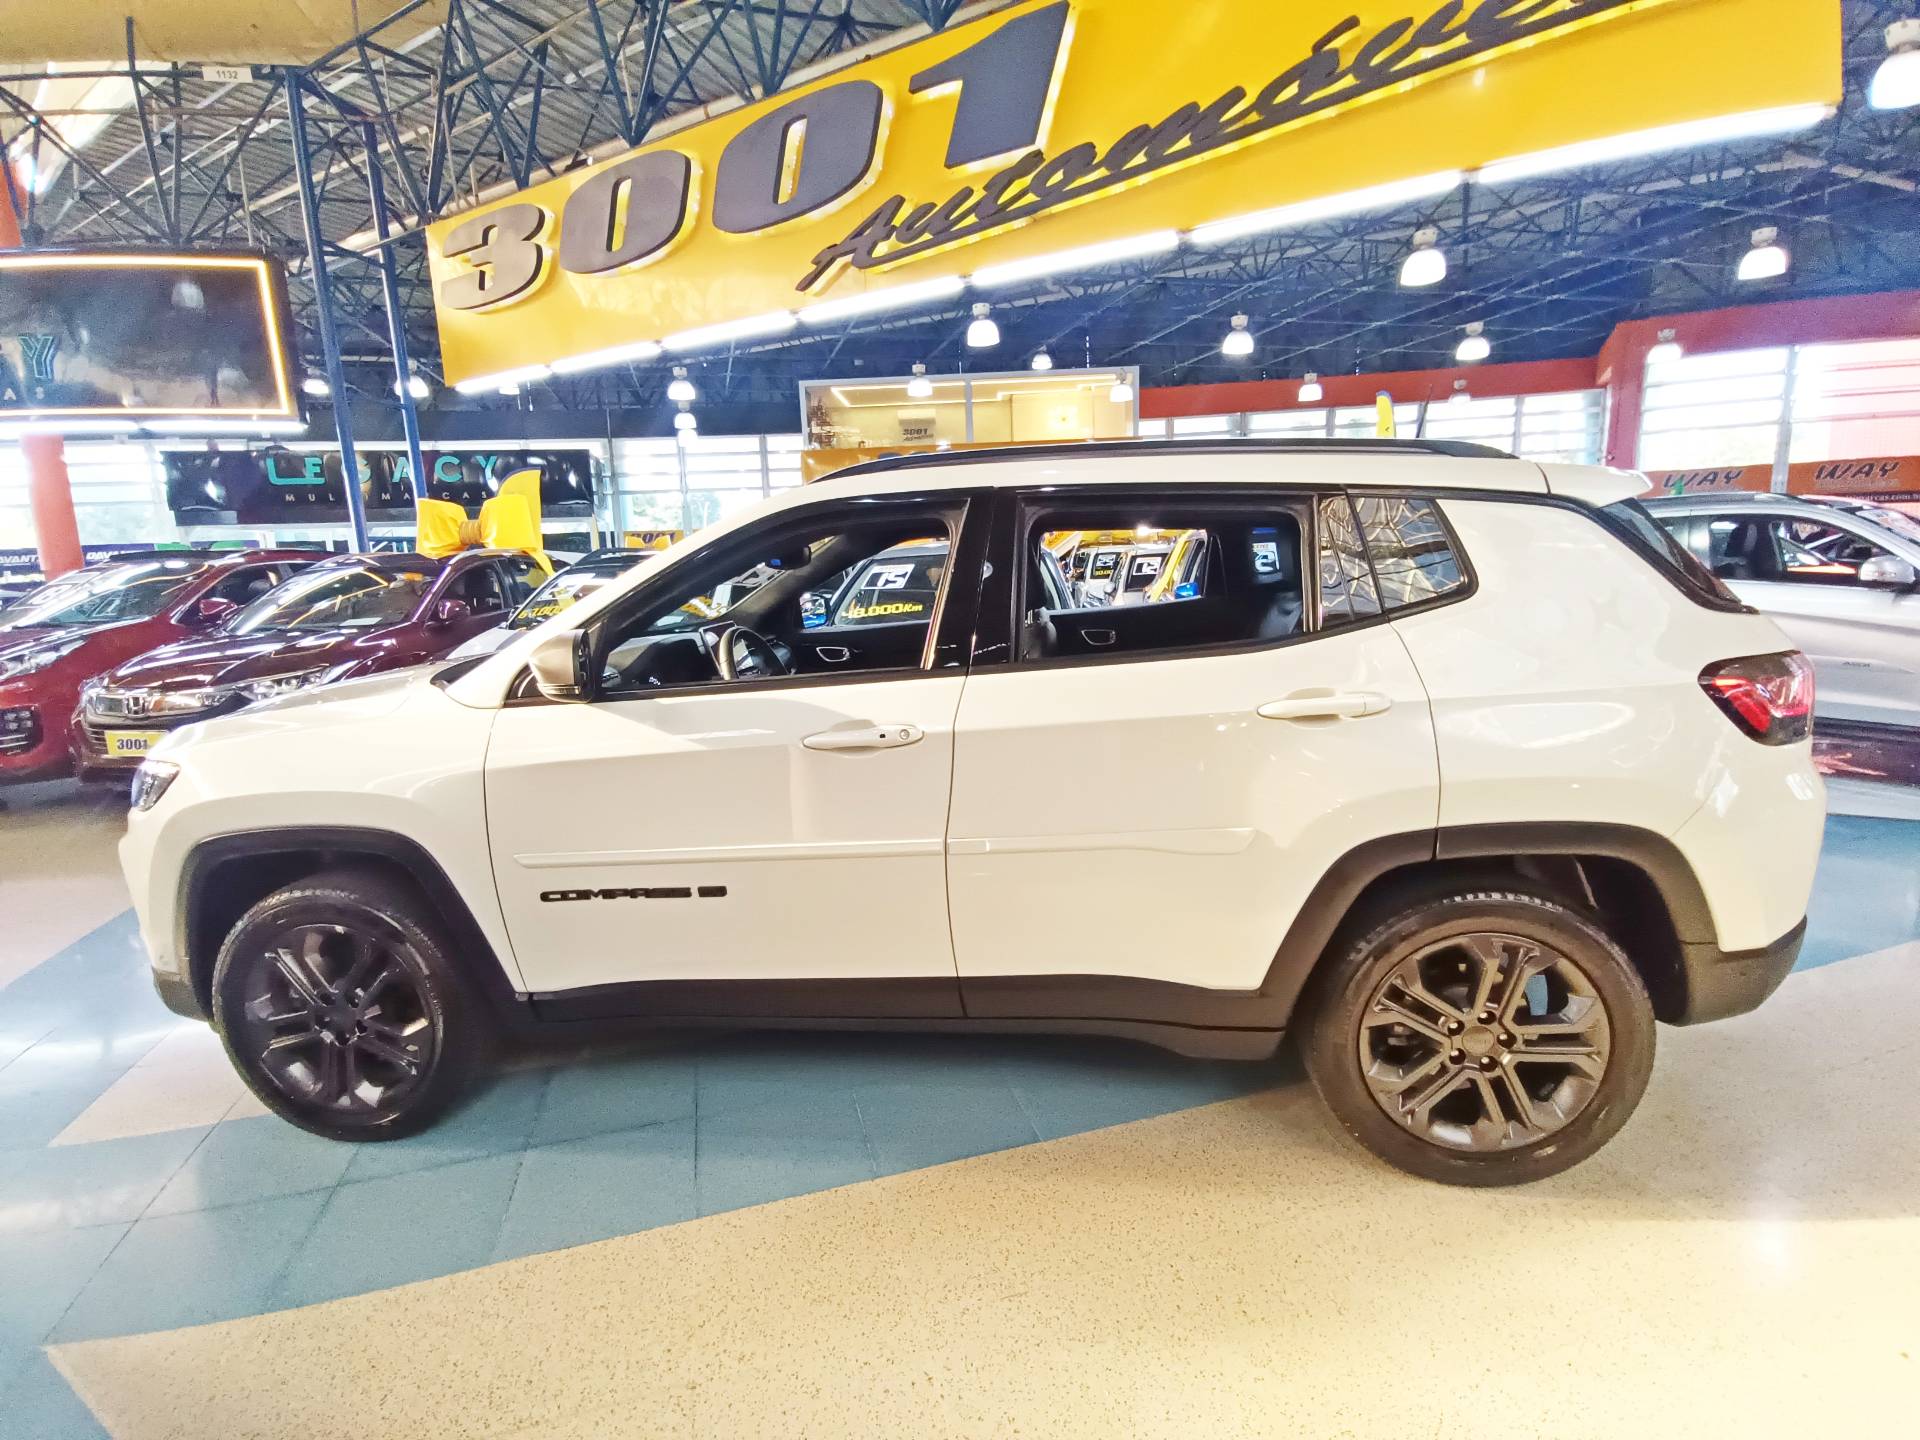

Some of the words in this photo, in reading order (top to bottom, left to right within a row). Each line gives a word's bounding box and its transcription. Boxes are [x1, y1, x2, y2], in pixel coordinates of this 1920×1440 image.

[216, 70, 238, 80] 1132
[441, 0, 1070, 310] 3001
[1816, 461, 1900, 480] WAY
